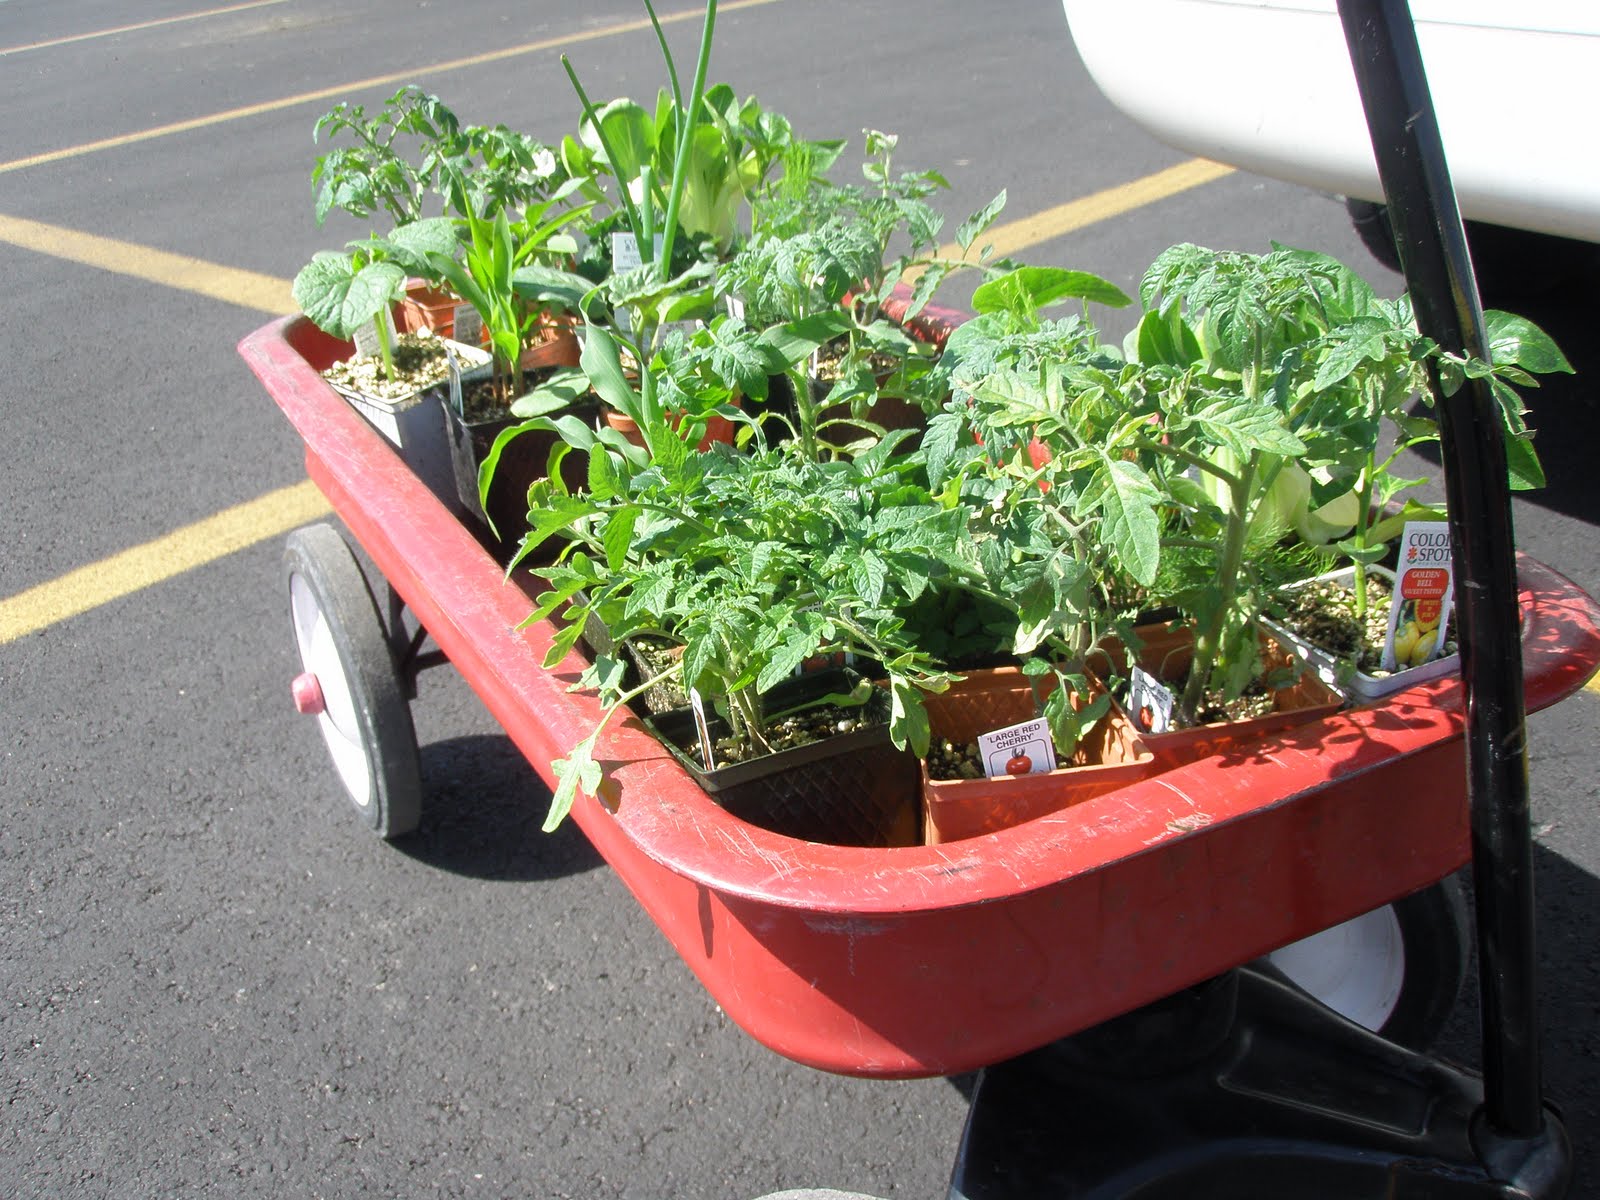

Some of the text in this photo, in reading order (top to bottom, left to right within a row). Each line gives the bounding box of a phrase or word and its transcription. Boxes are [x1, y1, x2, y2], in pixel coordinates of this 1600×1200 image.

[1418, 548, 1450, 562] SPOT
[1416, 579, 1433, 587] BELL
[1022, 723, 1040, 734] RED
